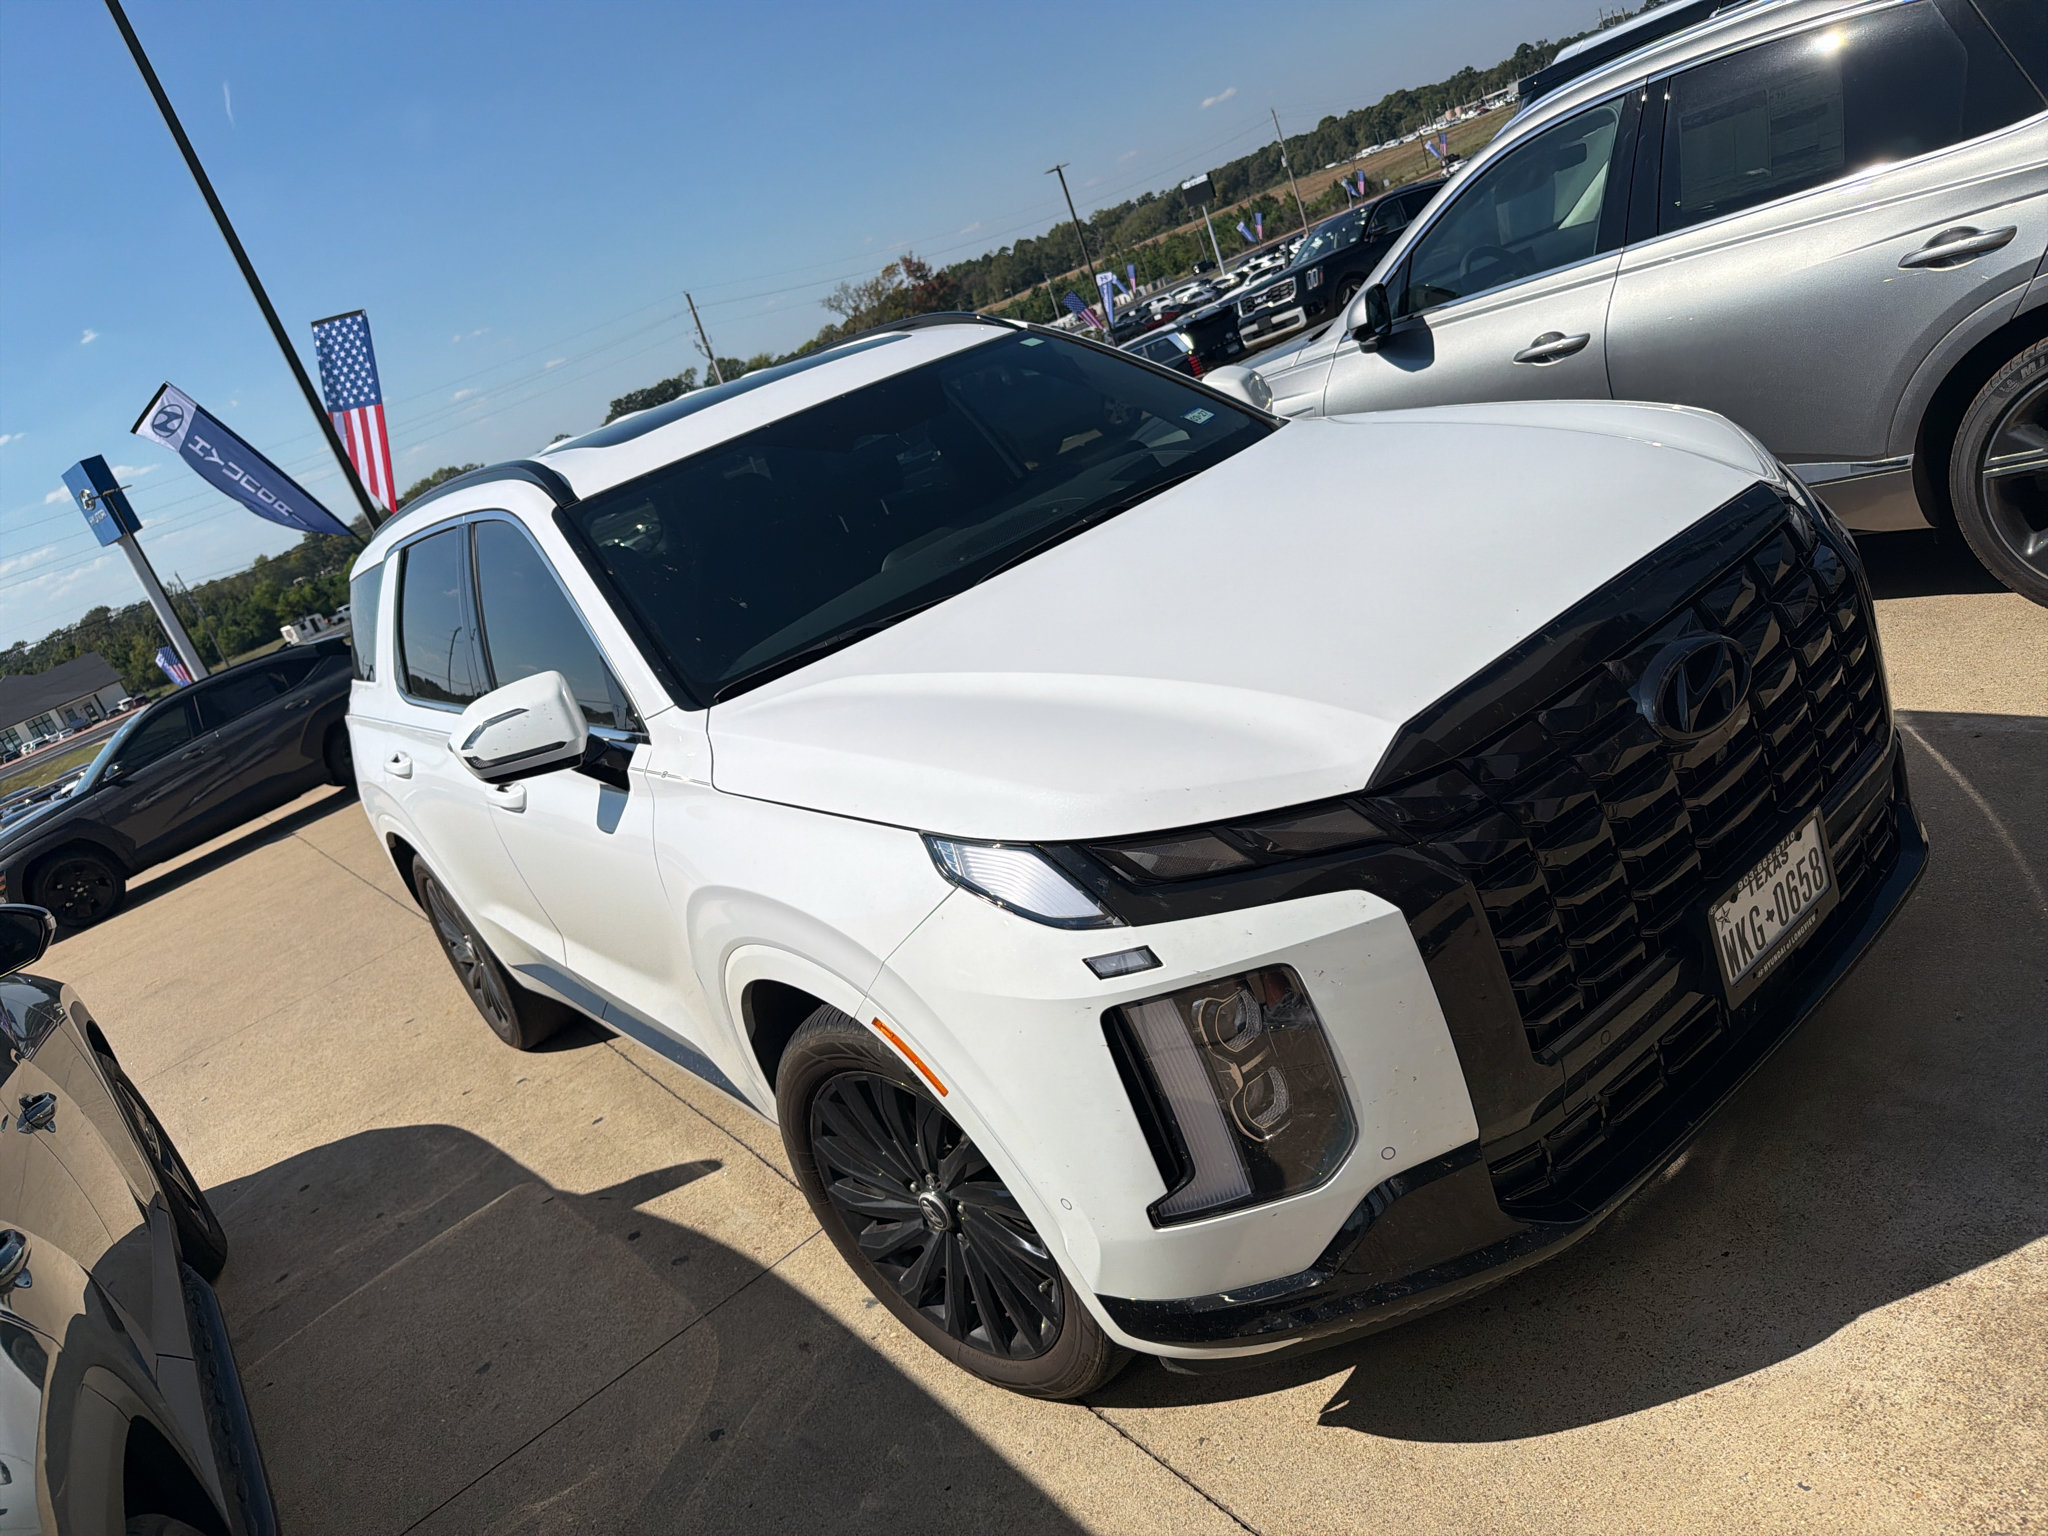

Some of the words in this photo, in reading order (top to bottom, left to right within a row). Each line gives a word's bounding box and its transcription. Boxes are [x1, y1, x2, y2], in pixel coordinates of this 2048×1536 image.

[187, 435, 307, 526] HYUNDAI
[1749, 851, 1789, 897] TEXAS
[1722, 905, 1767, 978] WKG
[1772, 847, 1825, 927] 0658
[1763, 943, 1788, 973] HYUNDAI
[1792, 912, 1818, 943] LONGVIEW
